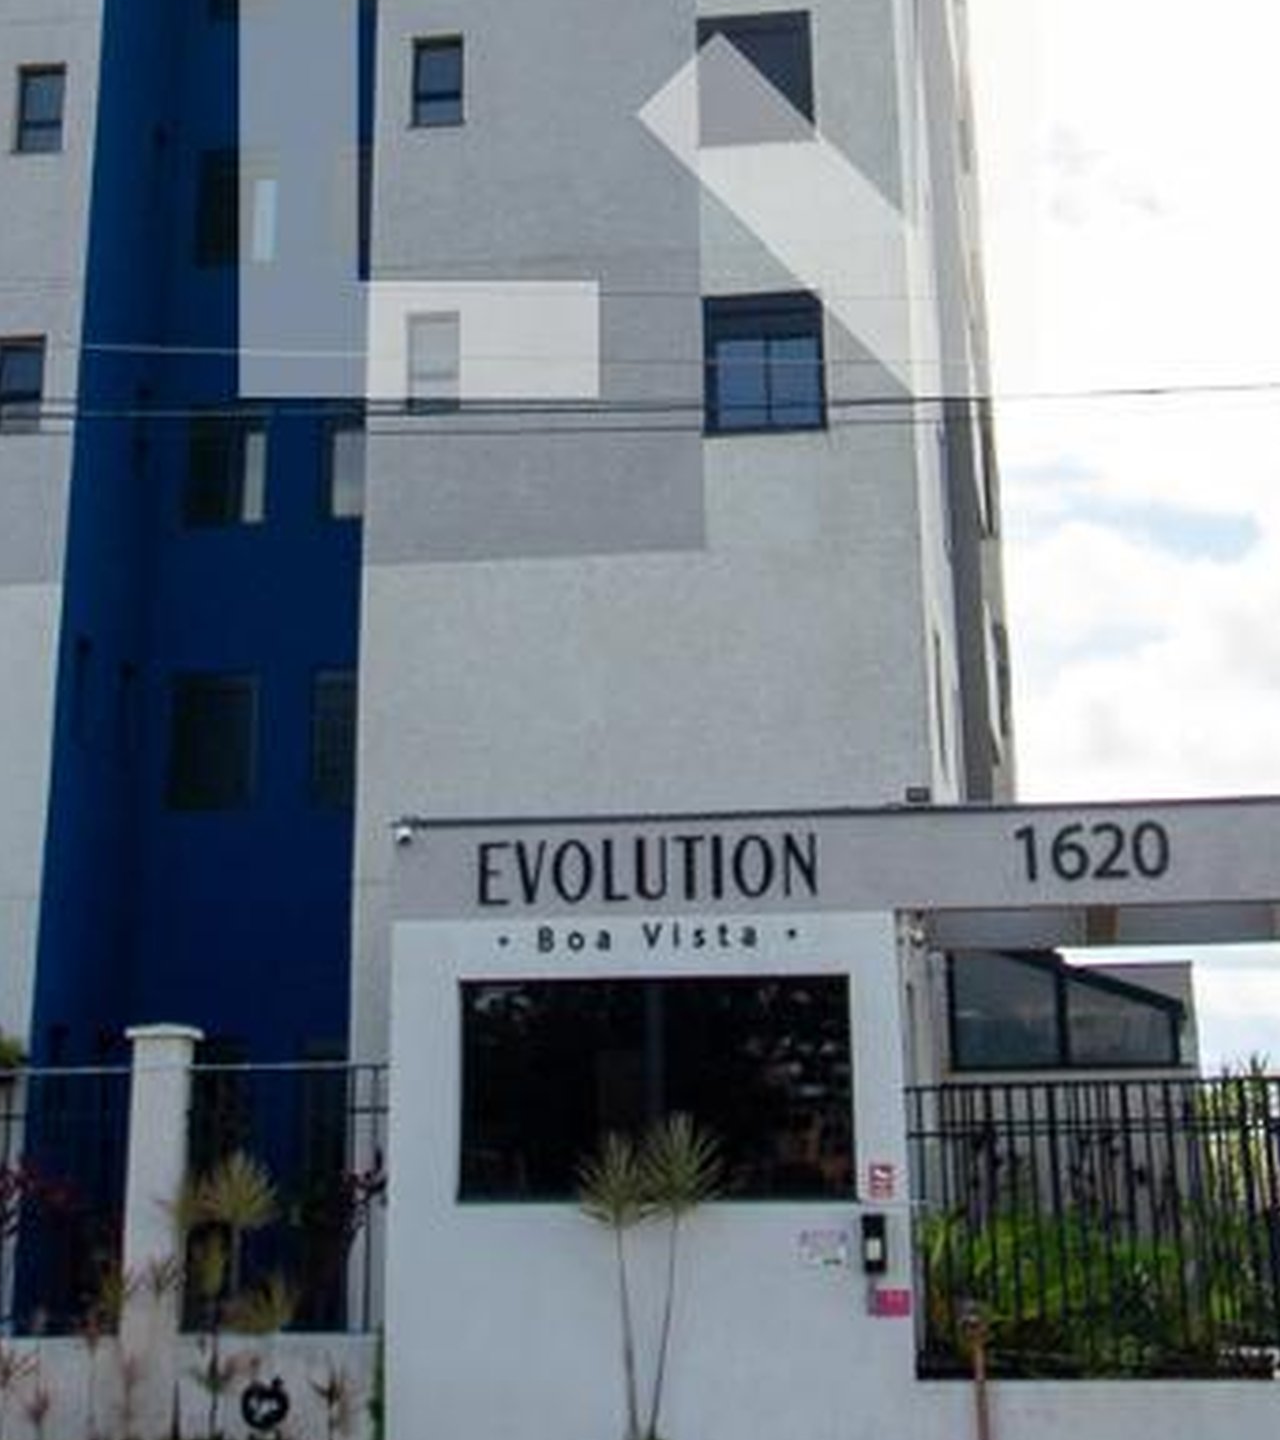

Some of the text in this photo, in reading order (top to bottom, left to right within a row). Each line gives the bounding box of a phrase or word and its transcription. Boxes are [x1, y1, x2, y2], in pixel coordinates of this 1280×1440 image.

[477, 831, 818, 905] EVOLUTION
[1014, 821, 1169, 882] 1620
[537, 922, 758, 952] Boa Vista
